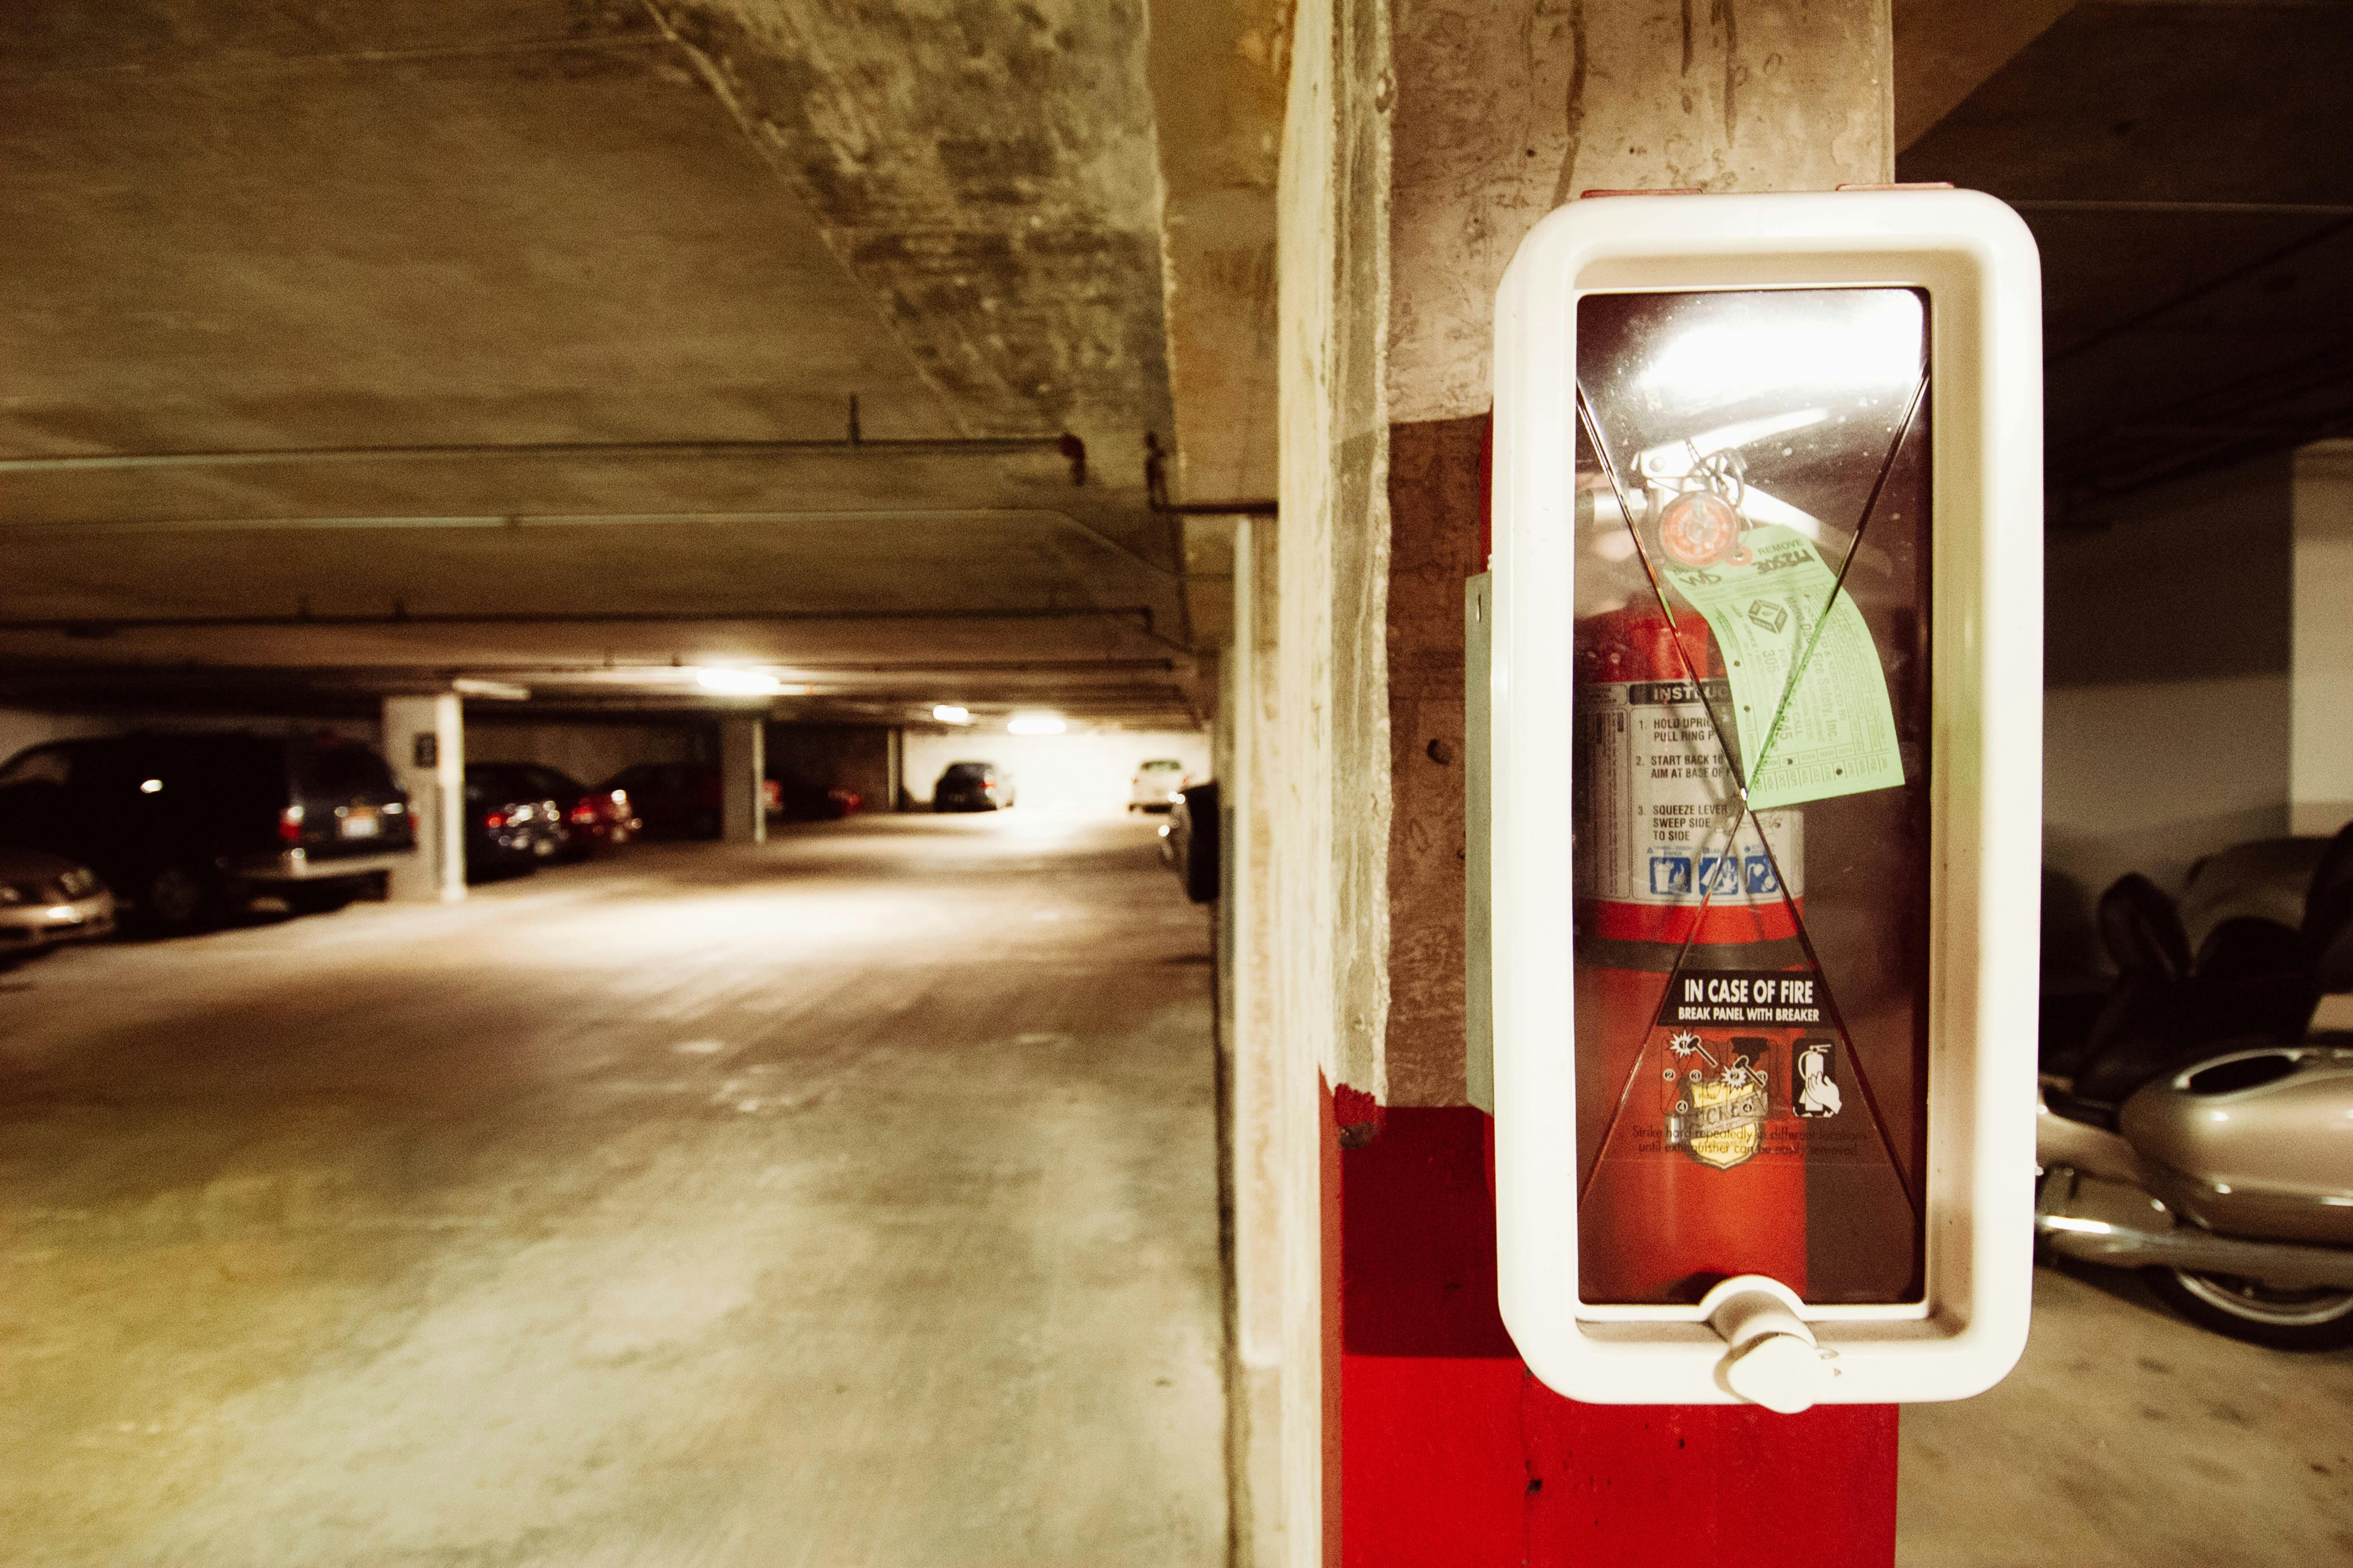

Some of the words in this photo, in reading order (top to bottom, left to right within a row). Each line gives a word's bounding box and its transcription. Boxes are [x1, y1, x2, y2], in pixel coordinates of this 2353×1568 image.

[1757, 539, 1804, 554] REMOVE
[1839, 709, 1847, 721] BY
[1640, 720, 1646, 729] 1.
[1654, 718, 1680, 729] HOLD
[1793, 712, 1803, 736] CALL
[1654, 731, 1678, 741] PULL
[1681, 731, 1704, 741] RING
[1826, 720, 1837, 741] Inc.
[1636, 756, 1645, 766] 2.
[1650, 755, 1681, 766] START
[1685, 755, 1708, 766] BACK
[1651, 768, 1668, 778] AIM
[1671, 768, 1682, 778] AT
[1685, 767, 1709, 778] BASE
[1653, 805, 1695, 816] SQUEEZE
[1698, 805, 1727, 815] LEVER
[1653, 817, 1686, 828] SWEEP
[1689, 817, 1710, 828] SIDE
[1653, 831, 1665, 840] TO
[1668, 830, 1690, 841] SIDE
[1684, 979, 1703, 1003] IN
[1707, 979, 1749, 1003] CASE
[1753, 979, 1775, 1003] OF
[1780, 979, 1814, 1005] FIRE
[1678, 1007, 1711, 1021] BREAK
[1713, 1008, 1744, 1021] PANEL
[1746, 1007, 1773, 1022] WITH
[1775, 1008, 1819, 1022] BREAKER
[1632, 1126, 1663, 1137] Strike
[1665, 1126, 1691, 1138] hard
[1695, 1126, 1753, 1142] repeatedly
[1638, 1141, 1661, 1153] until
